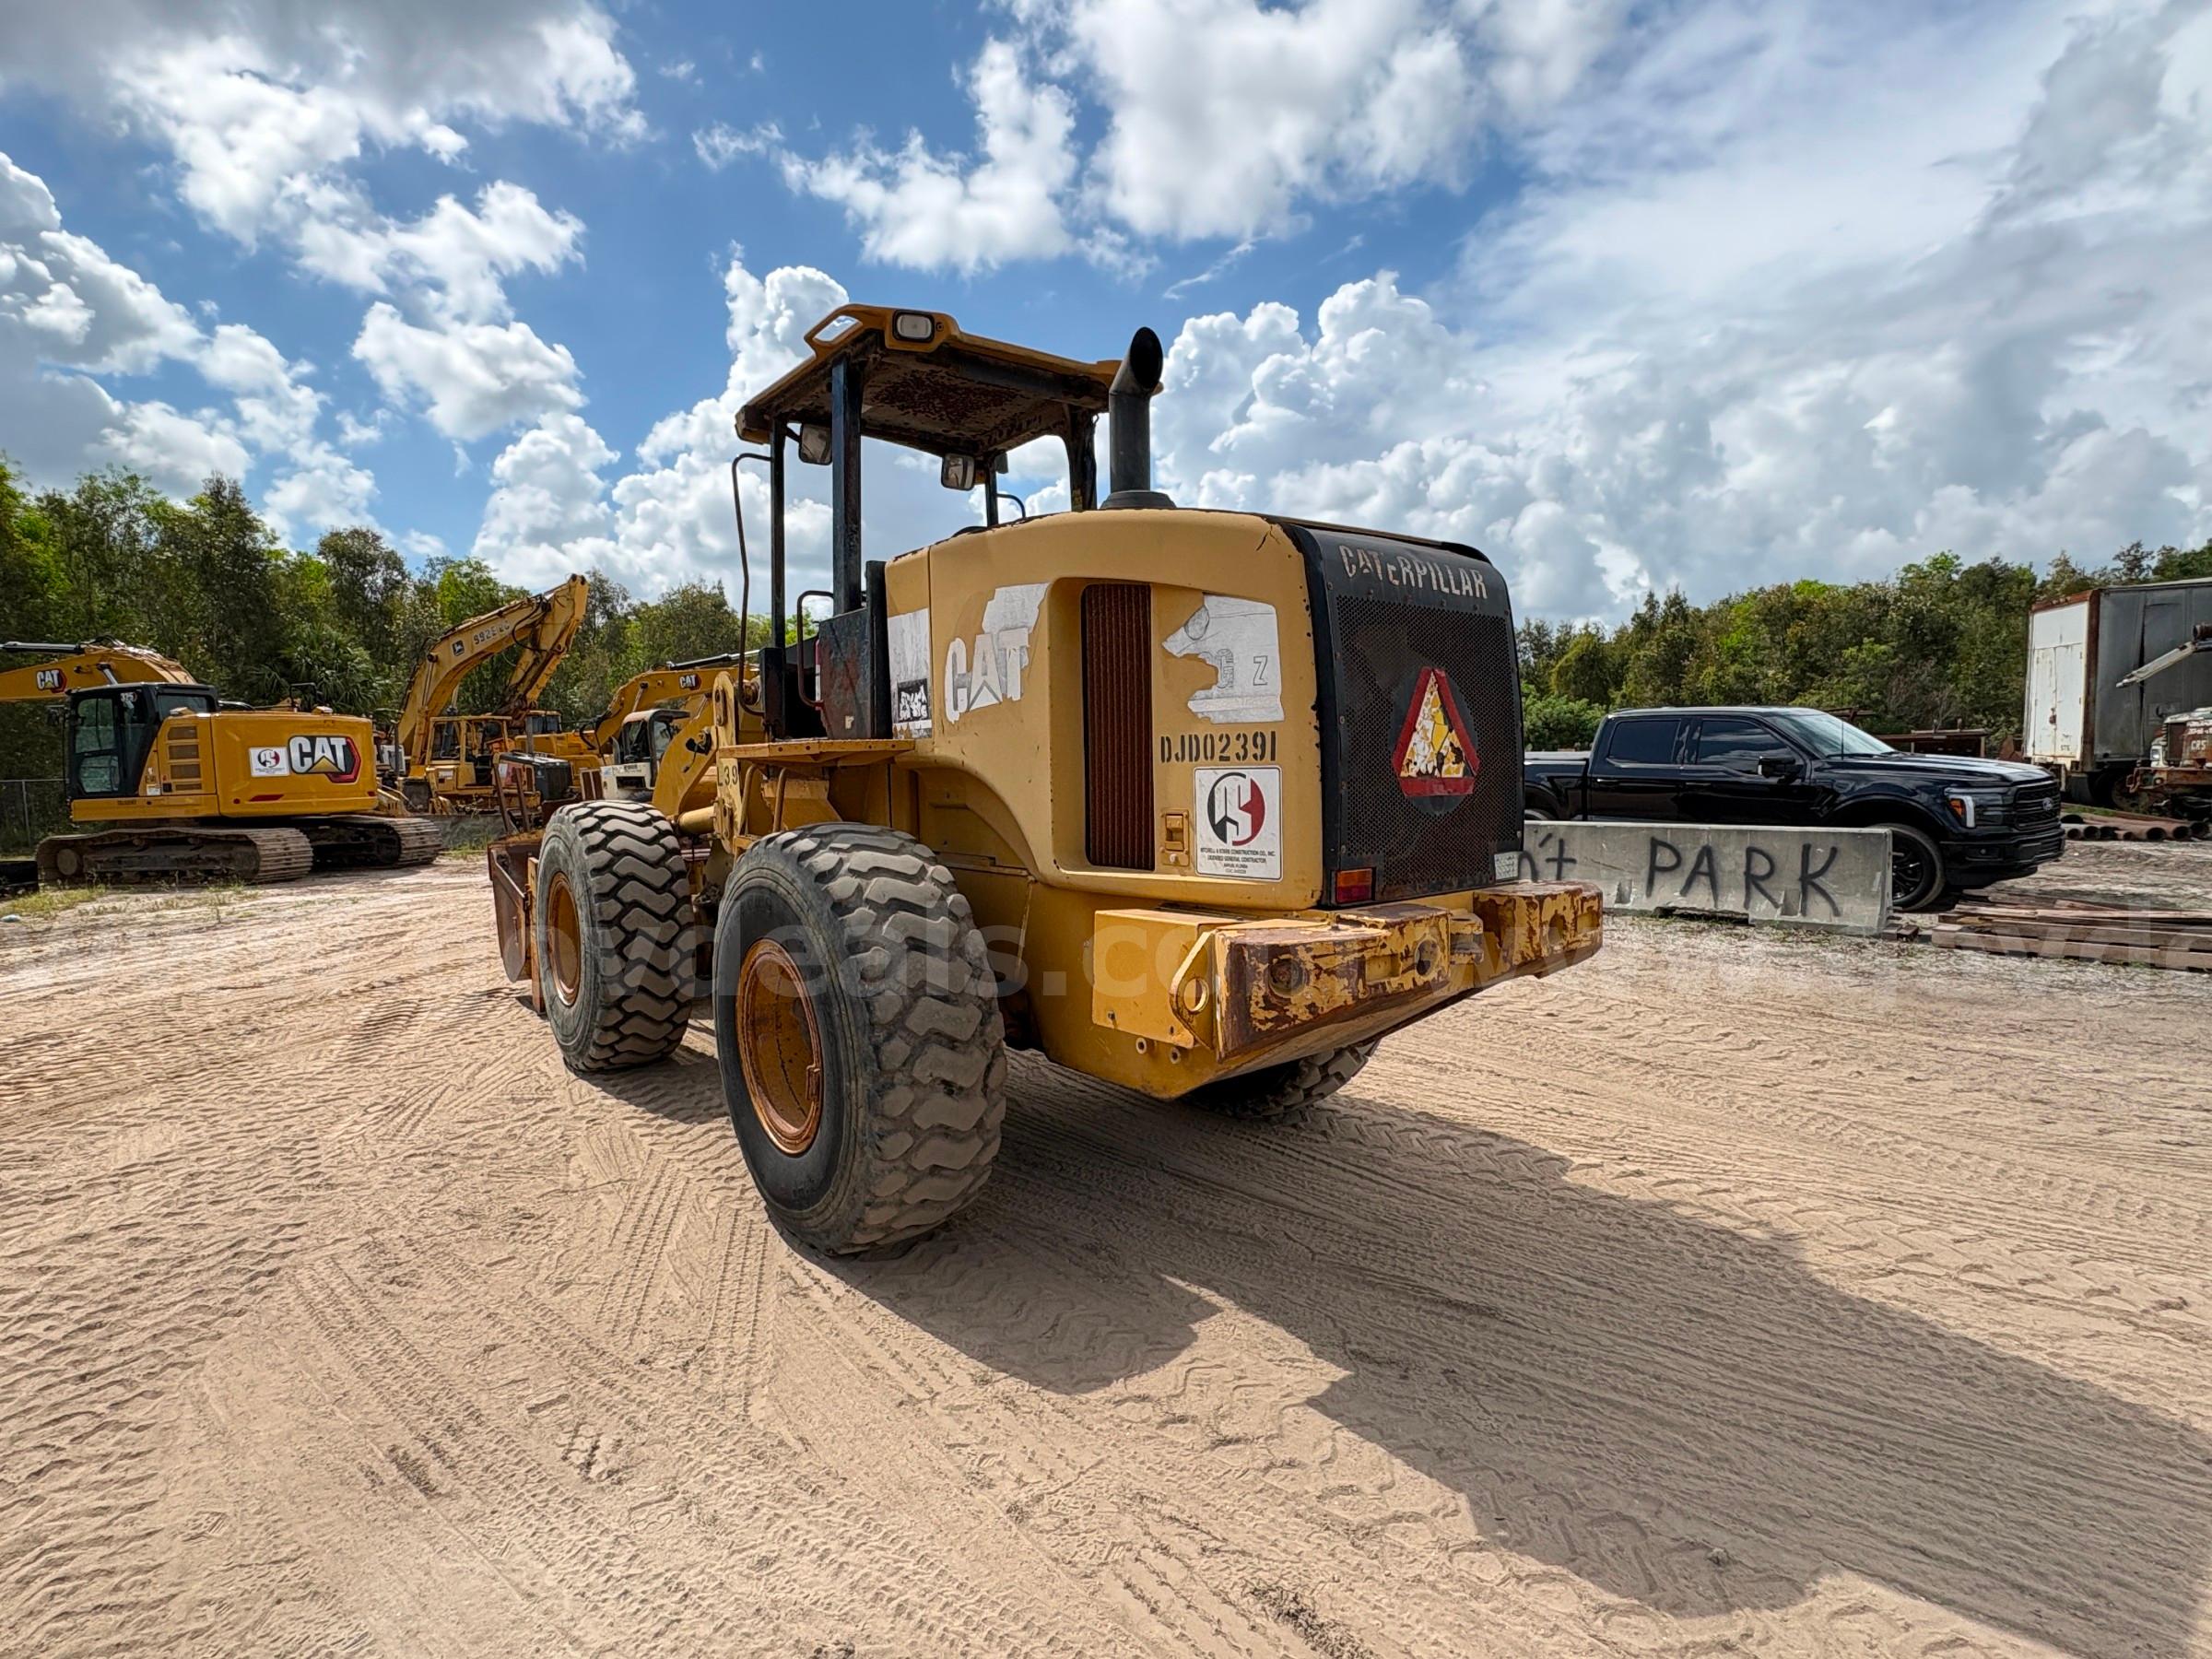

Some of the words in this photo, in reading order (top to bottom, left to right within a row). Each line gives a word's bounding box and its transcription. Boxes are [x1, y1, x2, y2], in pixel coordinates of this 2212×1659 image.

[1339, 545, 1488, 599] CATERPILLAR
[37, 670, 60, 689] CAT
[679, 675, 696, 688] CAT
[945, 628, 1030, 724] CAT
[289, 736, 347, 773] CAT
[1160, 731, 1276, 763] DJD02391
[1645, 836, 1841, 917] PARK
